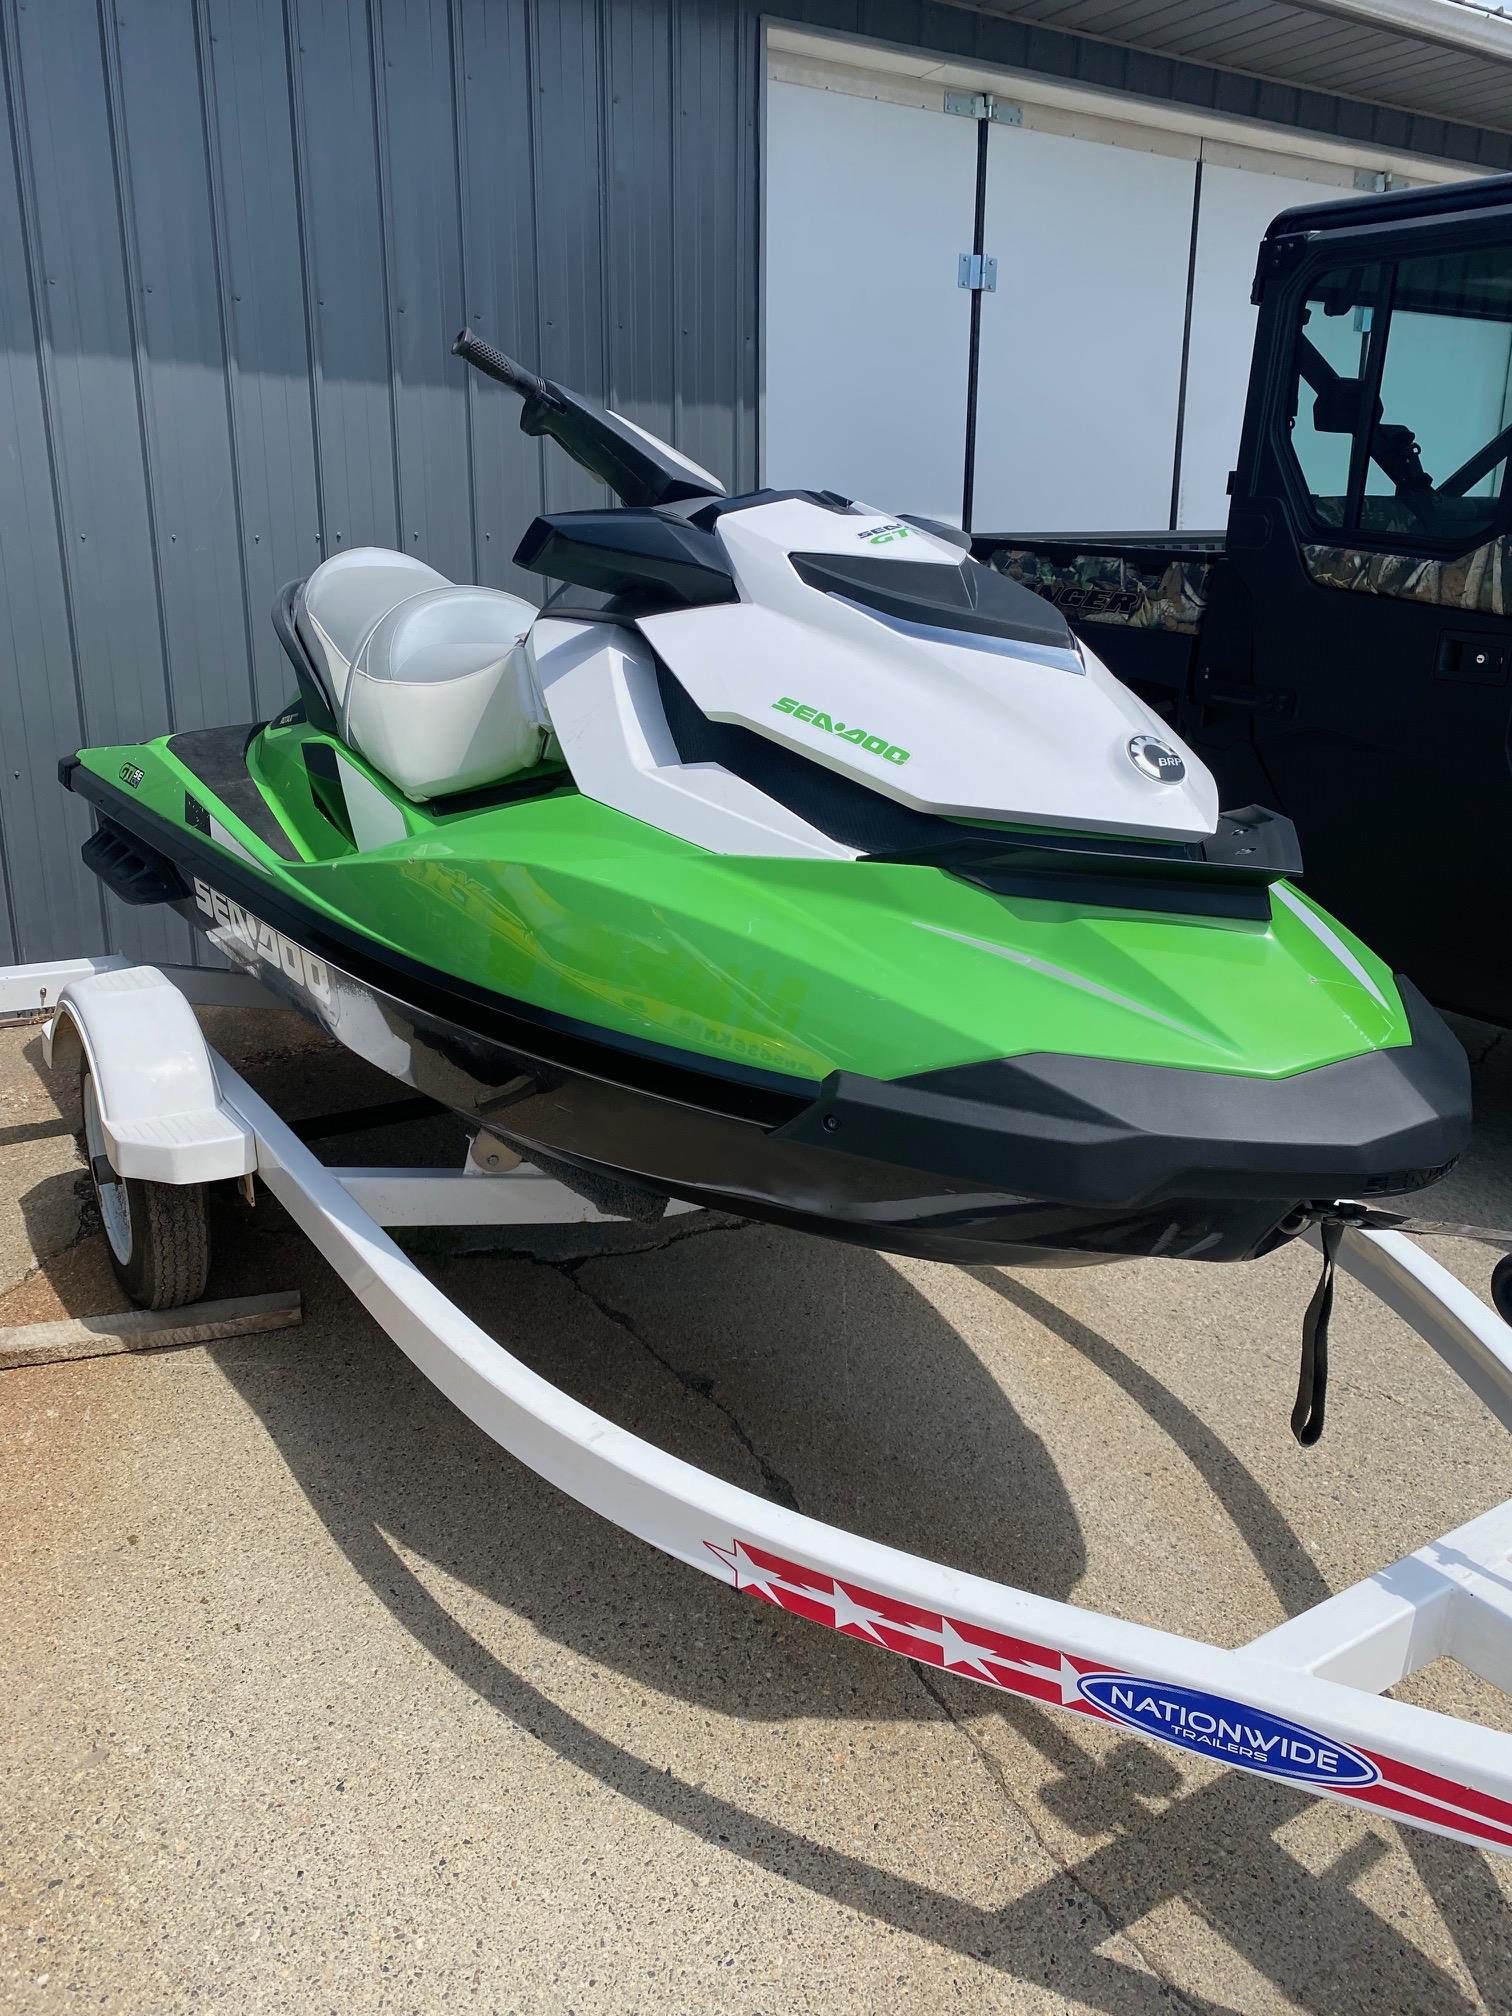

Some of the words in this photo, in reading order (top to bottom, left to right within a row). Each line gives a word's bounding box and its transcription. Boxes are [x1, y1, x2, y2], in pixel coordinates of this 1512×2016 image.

[1158, 757, 1181, 767] BRP
[1111, 1686, 1339, 1773] NATIONWIDE
[1171, 1726, 1268, 1763] TRAILERS
